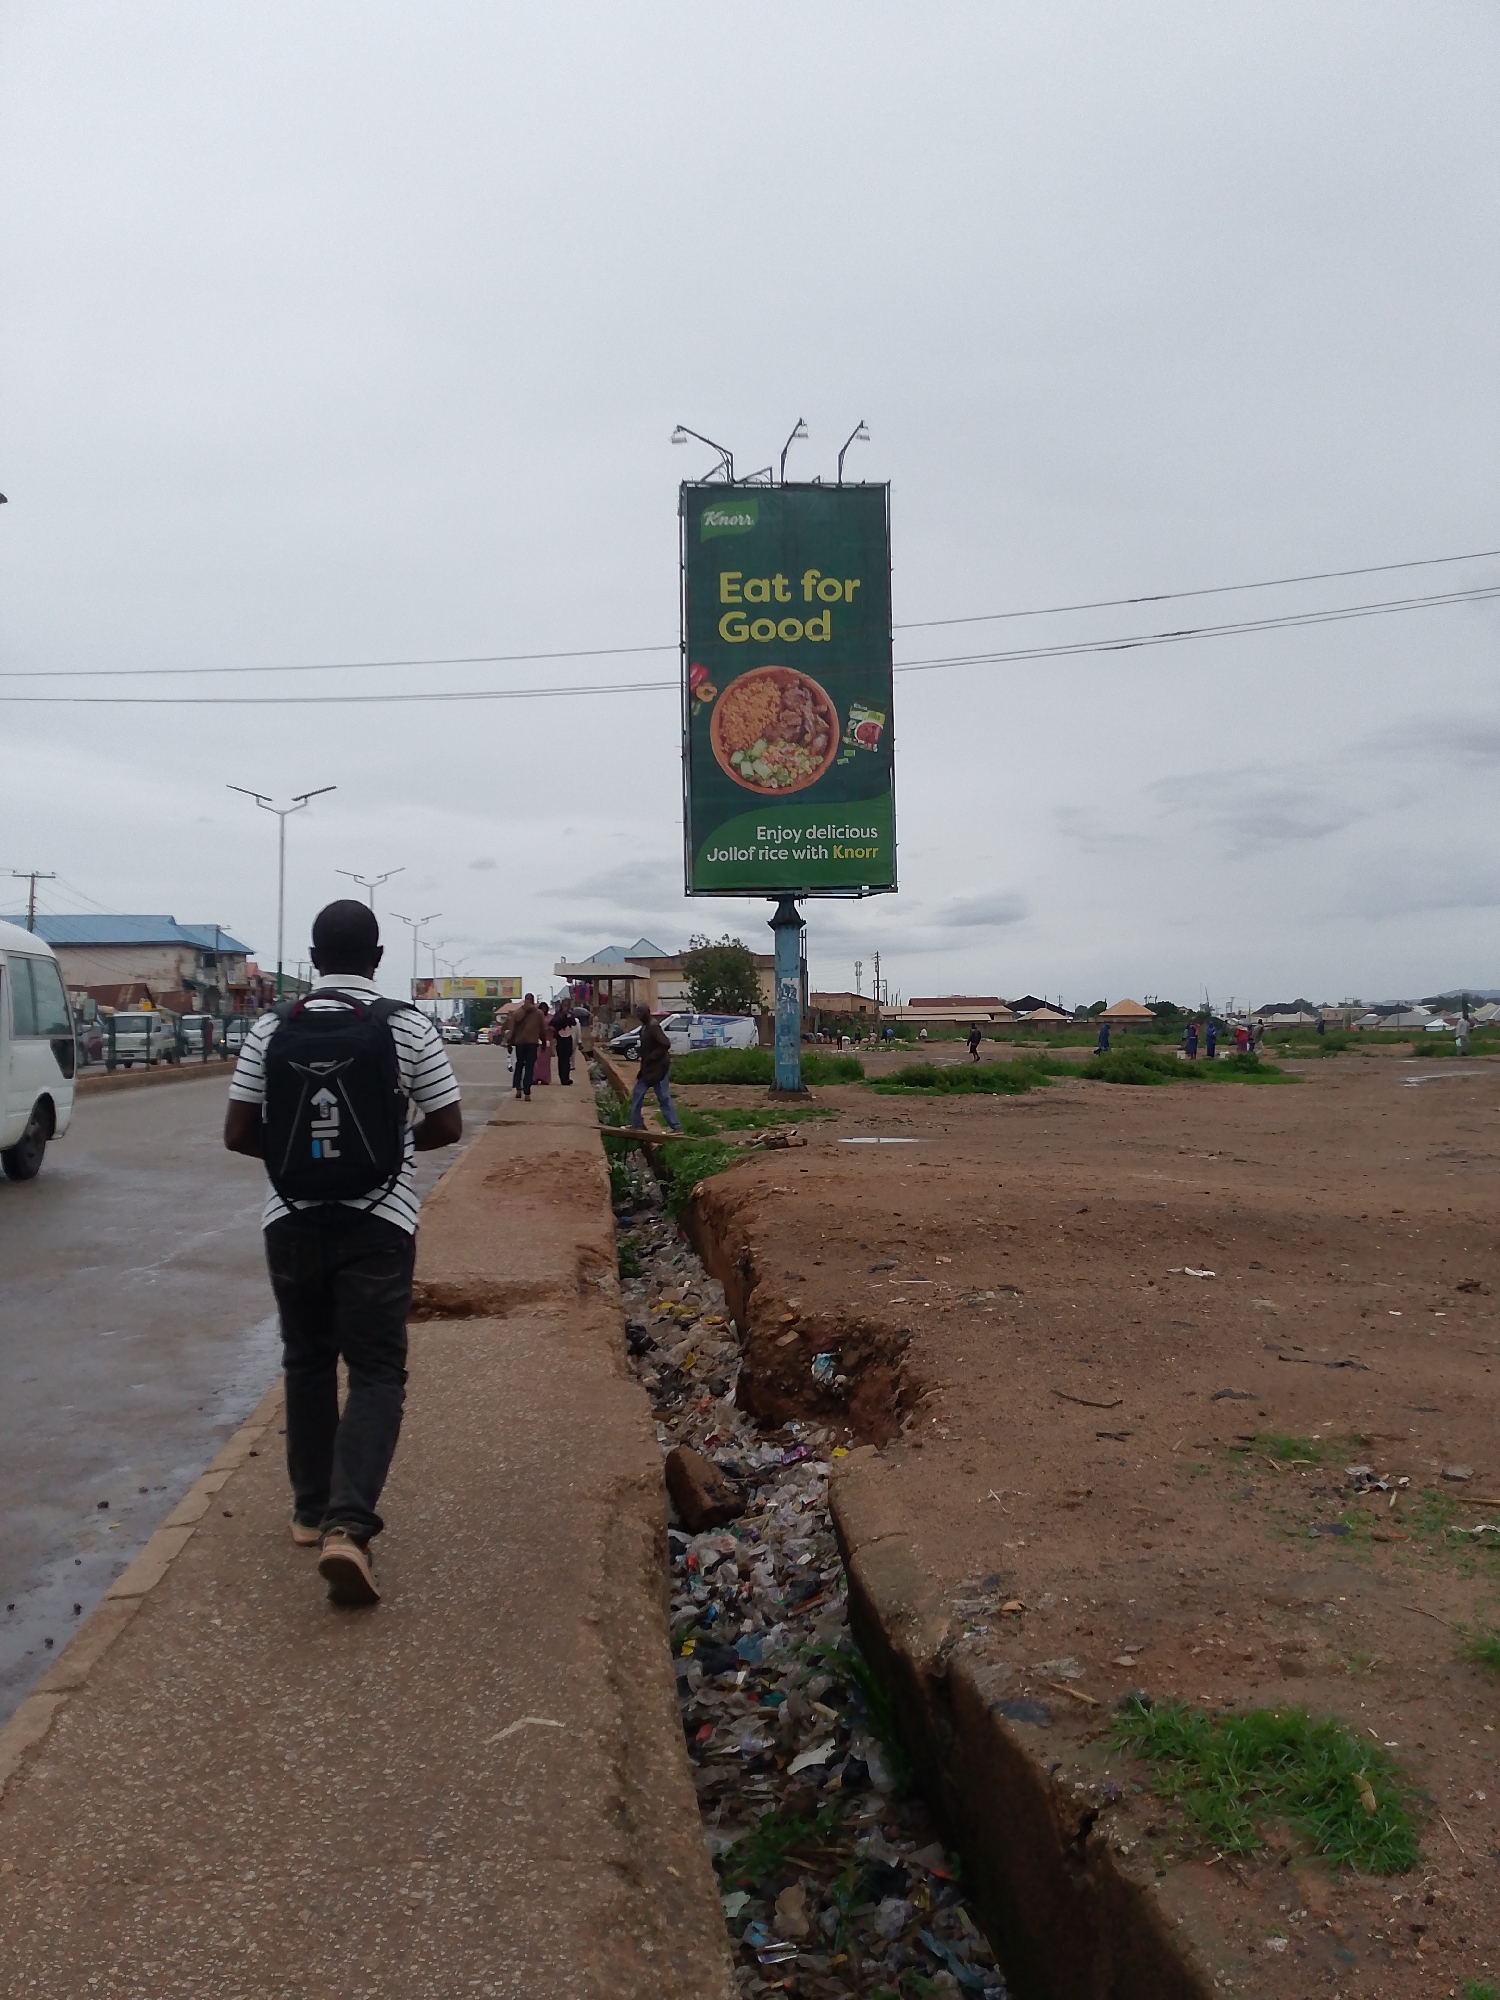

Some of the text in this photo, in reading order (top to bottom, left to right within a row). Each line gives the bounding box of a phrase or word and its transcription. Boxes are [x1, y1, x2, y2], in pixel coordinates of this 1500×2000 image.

[703, 510, 753, 526] Knorr
[719, 568, 861, 604] Eat for
[718, 609, 831, 643] Good
[756, 824, 878, 844] Enjoy delicious
[706, 844, 879, 862] Jollof rice with Knorr
